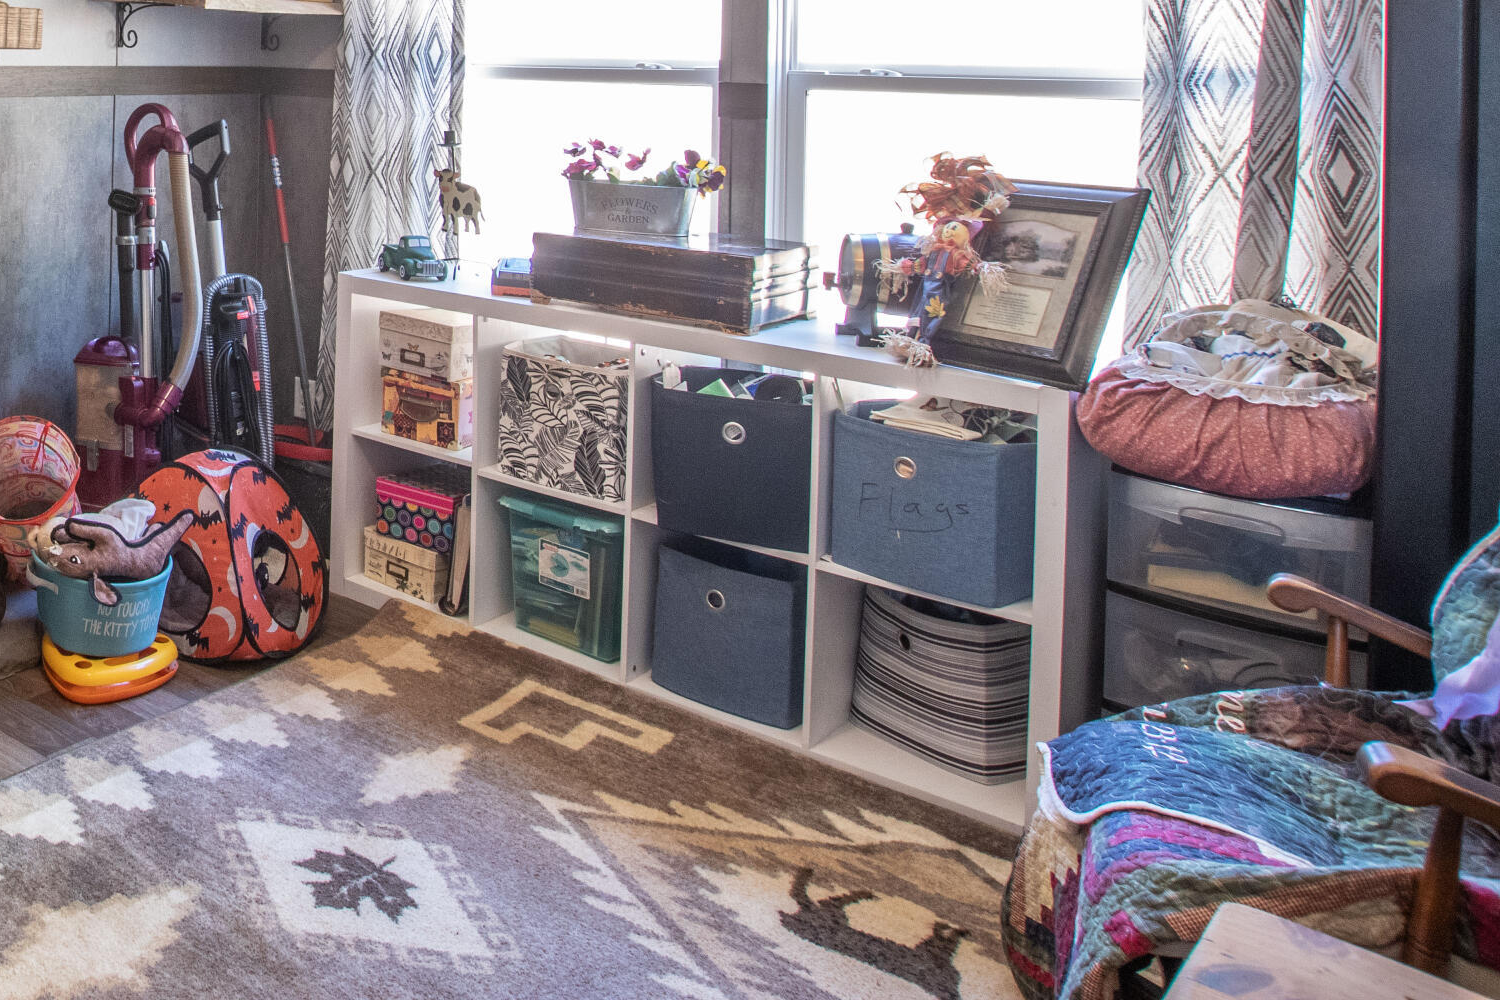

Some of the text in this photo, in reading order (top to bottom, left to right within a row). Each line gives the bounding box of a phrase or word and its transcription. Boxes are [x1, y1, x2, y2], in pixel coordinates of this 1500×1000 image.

[600, 197, 659, 214] FLOWERS
[607, 213, 651, 224] GARDEN
[859, 482, 970, 533] Flags
[82, 618, 102, 636] THE
[103, 620, 138, 639] KITTY
